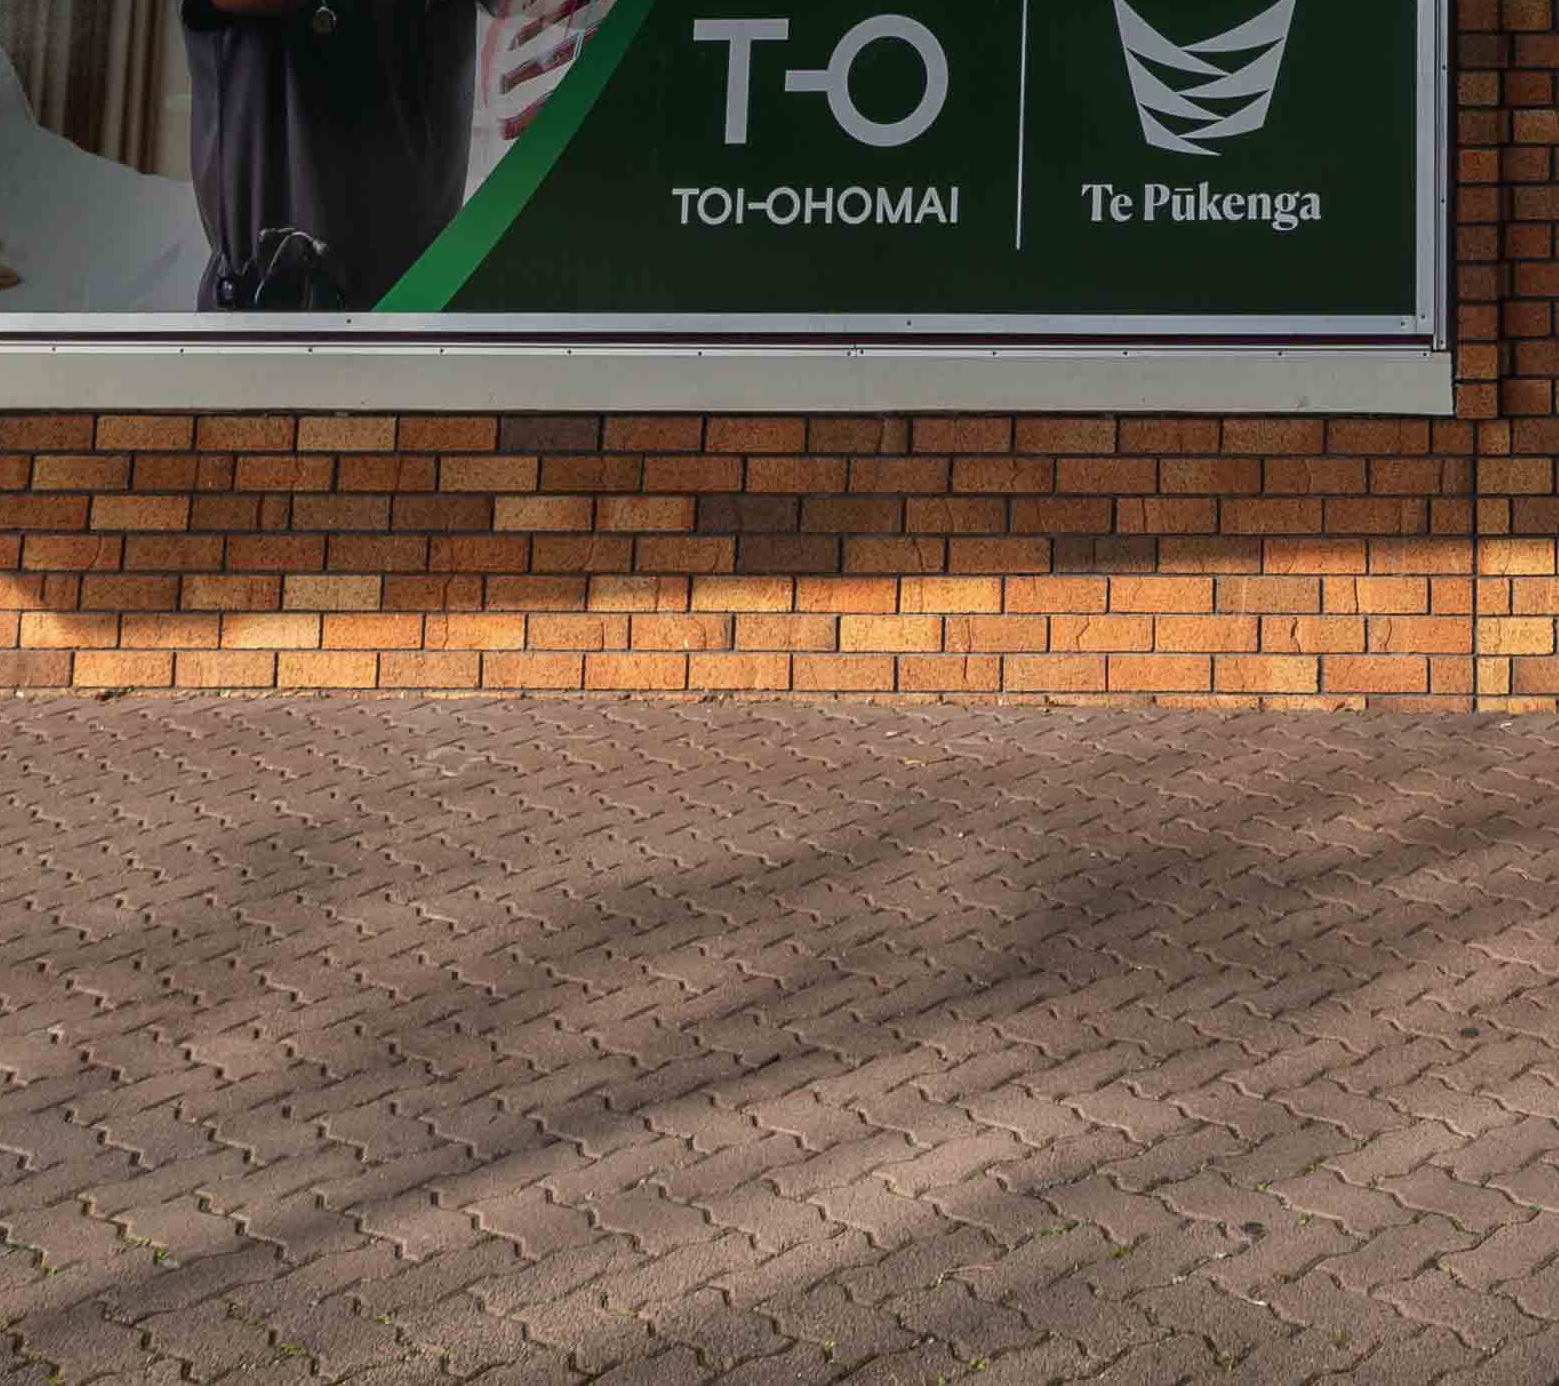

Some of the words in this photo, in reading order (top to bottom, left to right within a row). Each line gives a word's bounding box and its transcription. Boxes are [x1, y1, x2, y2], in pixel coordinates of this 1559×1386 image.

[671, 187, 960, 226] TOI-OHOMAI
[1081, 183, 1133, 222] Te
[1143, 182, 1322, 231] Pūkenga
